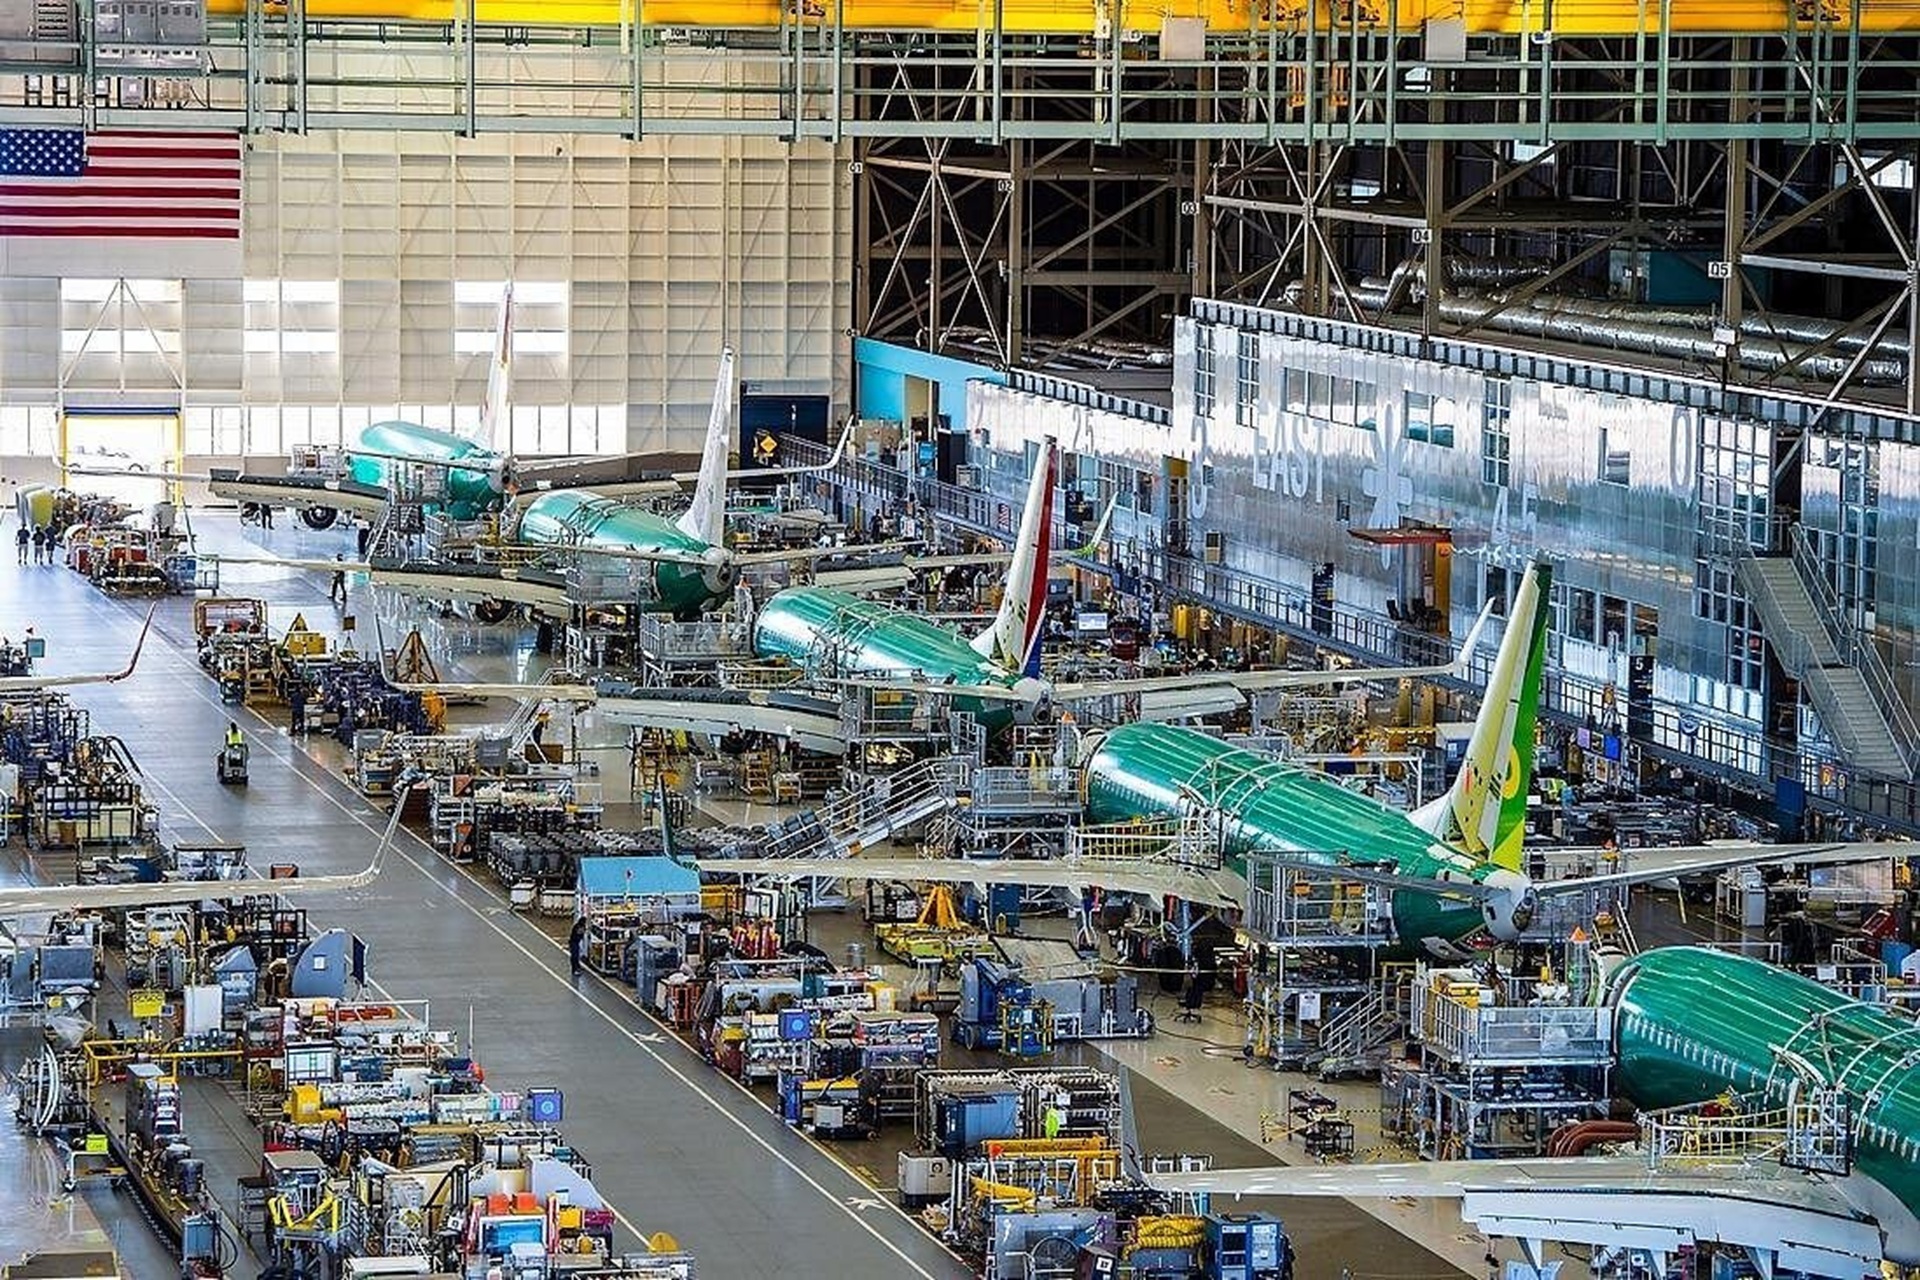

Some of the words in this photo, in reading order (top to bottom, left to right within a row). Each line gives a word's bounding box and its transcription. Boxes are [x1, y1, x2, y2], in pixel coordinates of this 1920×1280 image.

[1000, 180, 1012, 191] 02
[1184, 202, 1197, 215] 03
[1414, 230, 1429, 242] 04
[1711, 262, 1729, 277] 05
[1253, 400, 1330, 503] EAST
[1634, 656, 1644, 671] 5
